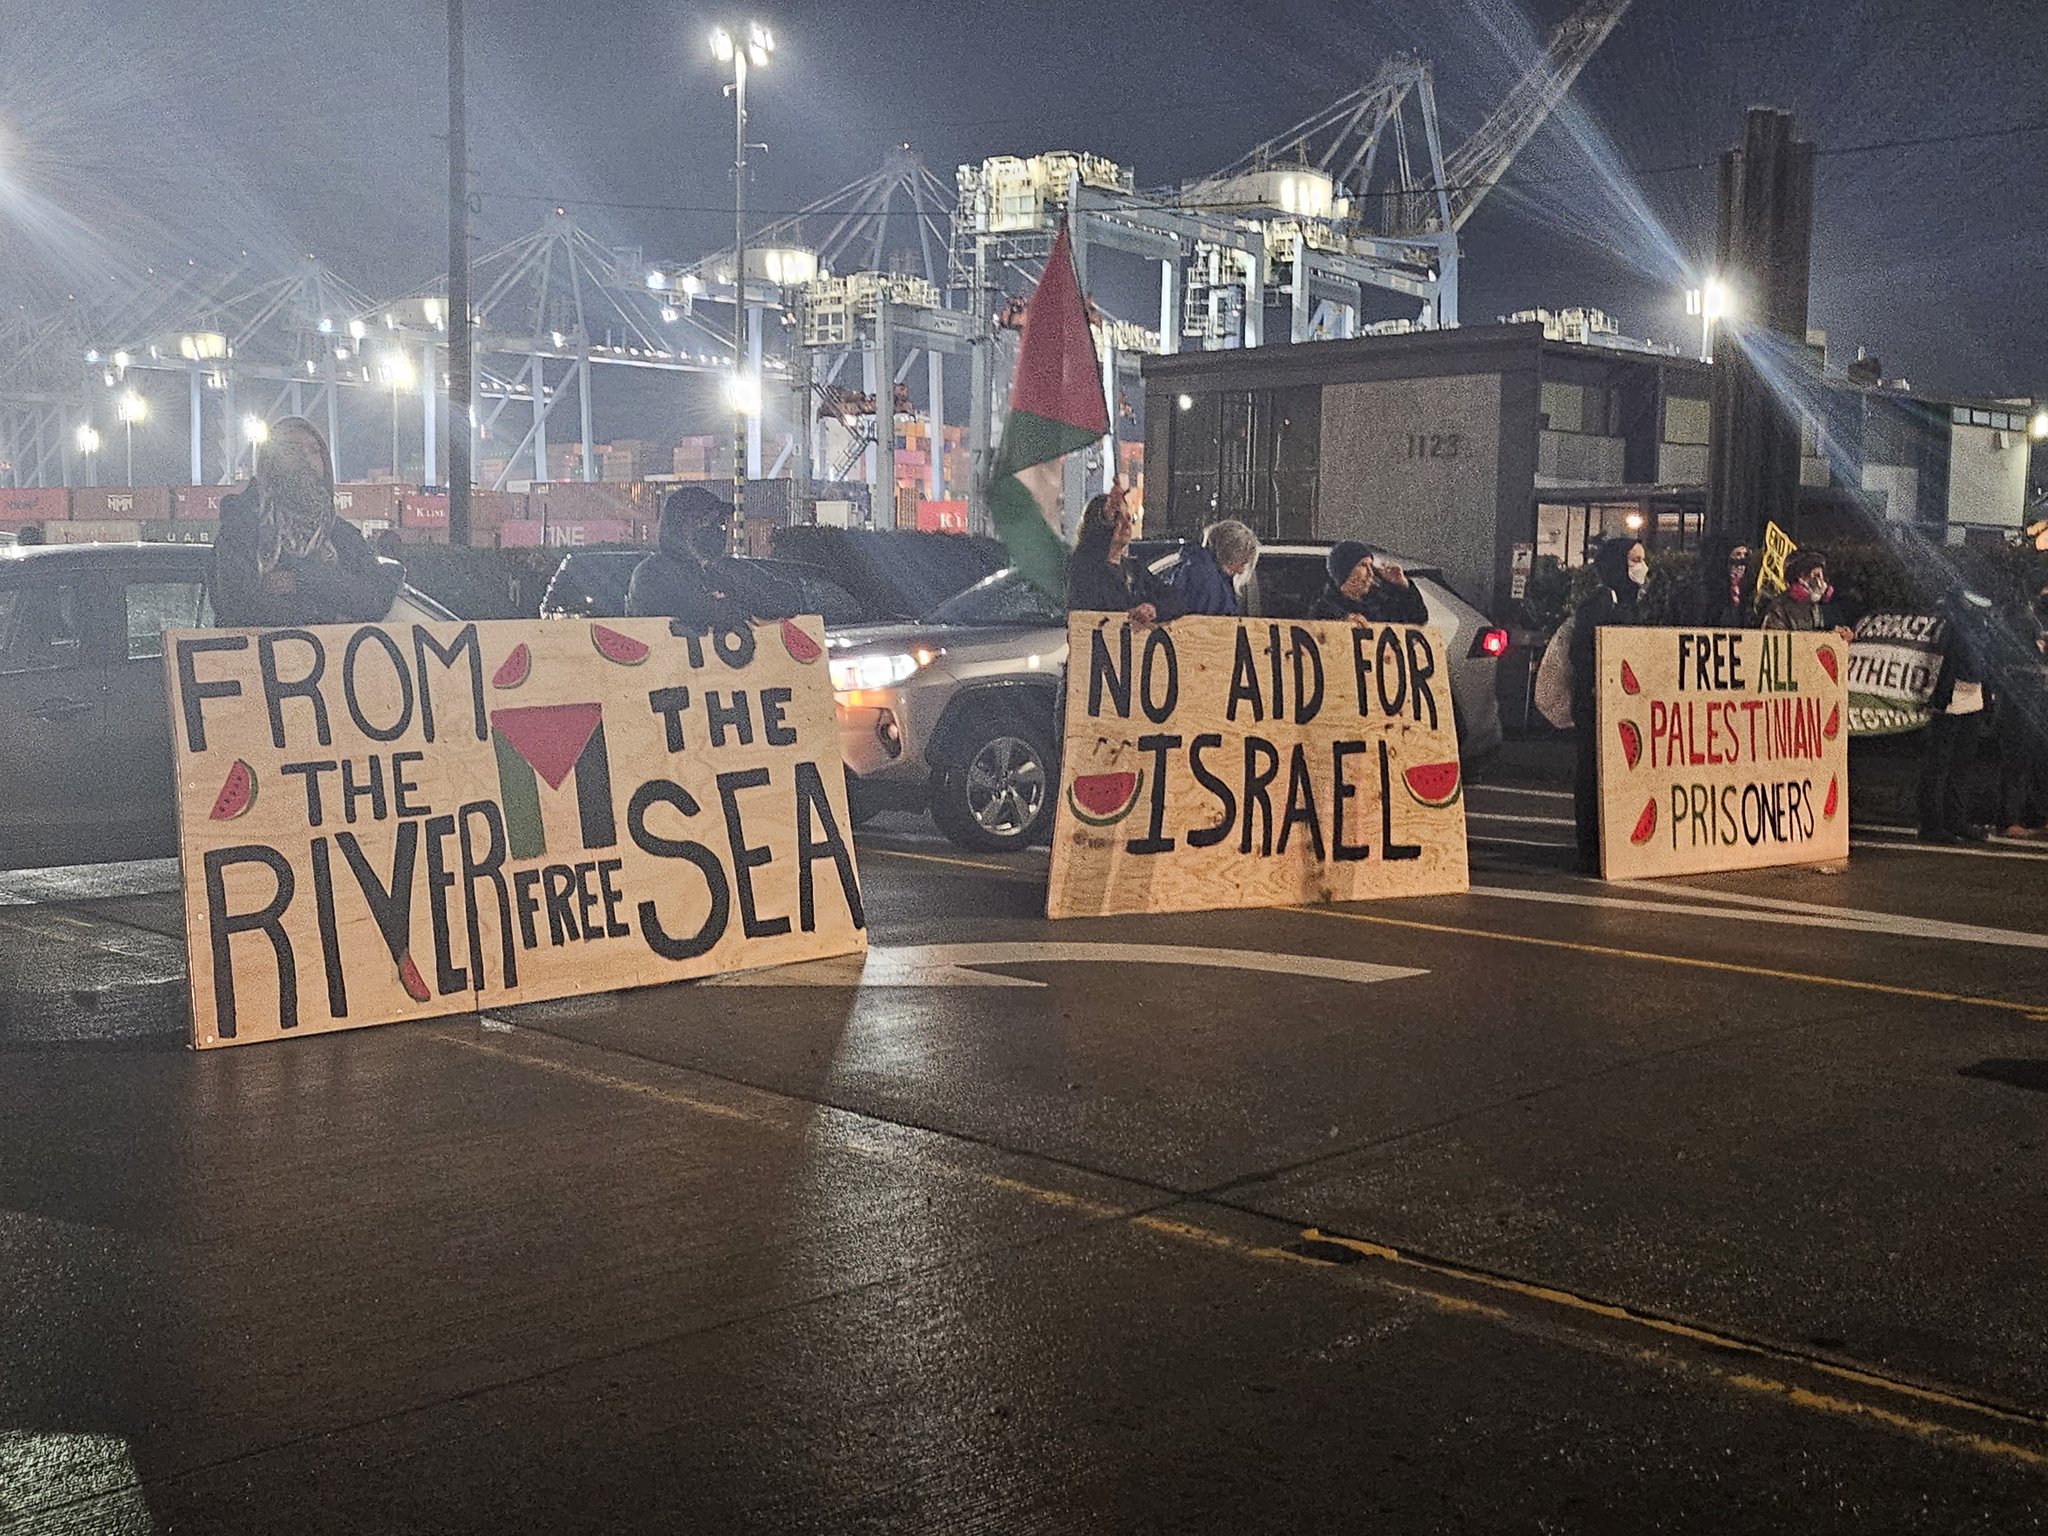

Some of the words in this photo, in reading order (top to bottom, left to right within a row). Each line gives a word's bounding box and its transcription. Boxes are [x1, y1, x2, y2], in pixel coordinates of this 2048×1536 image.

[669, 620, 756, 669] TO
[1087, 625, 1178, 724] NO
[1226, 623, 1325, 725] AID
[1351, 626, 1438, 730] FOR
[1678, 633, 1745, 691] FREE
[1757, 632, 1798, 694] ALL
[177, 623, 488, 753] FROM
[648, 686, 797, 753] THE
[1650, 697, 1823, 768] PALESTINIAN
[280, 751, 431, 826] THE
[1125, 733, 1422, 862] ISRAEL
[1671, 778, 1815, 851] PRISONERS
[627, 761, 865, 961] SEA
[204, 799, 518, 1038] RIVER
[514, 858, 630, 949] FREE
